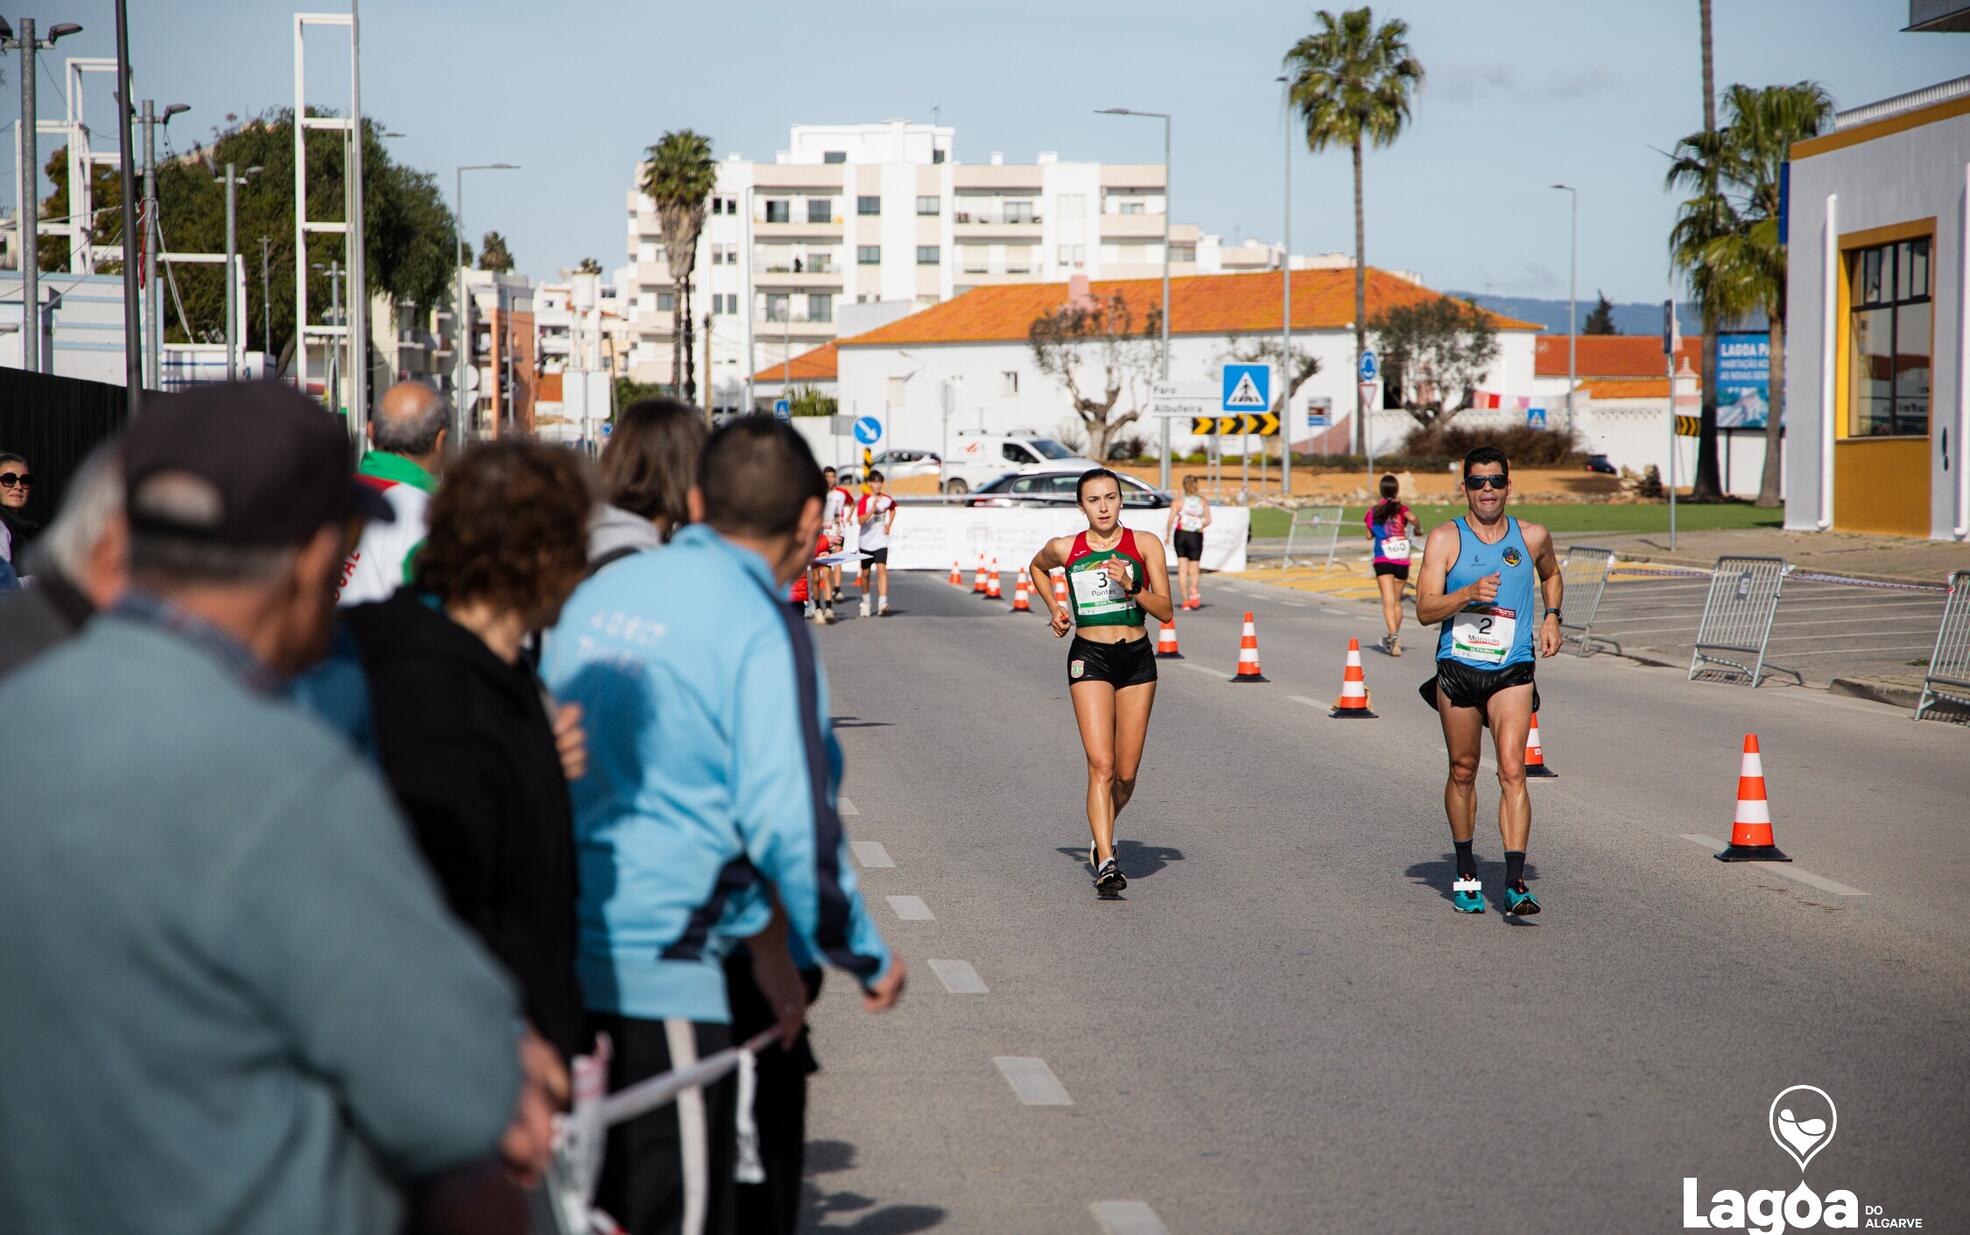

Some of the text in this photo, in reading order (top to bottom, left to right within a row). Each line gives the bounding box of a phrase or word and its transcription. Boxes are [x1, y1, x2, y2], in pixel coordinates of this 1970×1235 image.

[1720, 343, 1757, 357] LAGOA
[1153, 385, 1176, 395] Faro
[1153, 402, 1203, 413] Albufeira
[1096, 571, 1108, 588] 3
[1091, 588, 1117, 598] Pontes
[1478, 617, 1493, 635] 2
